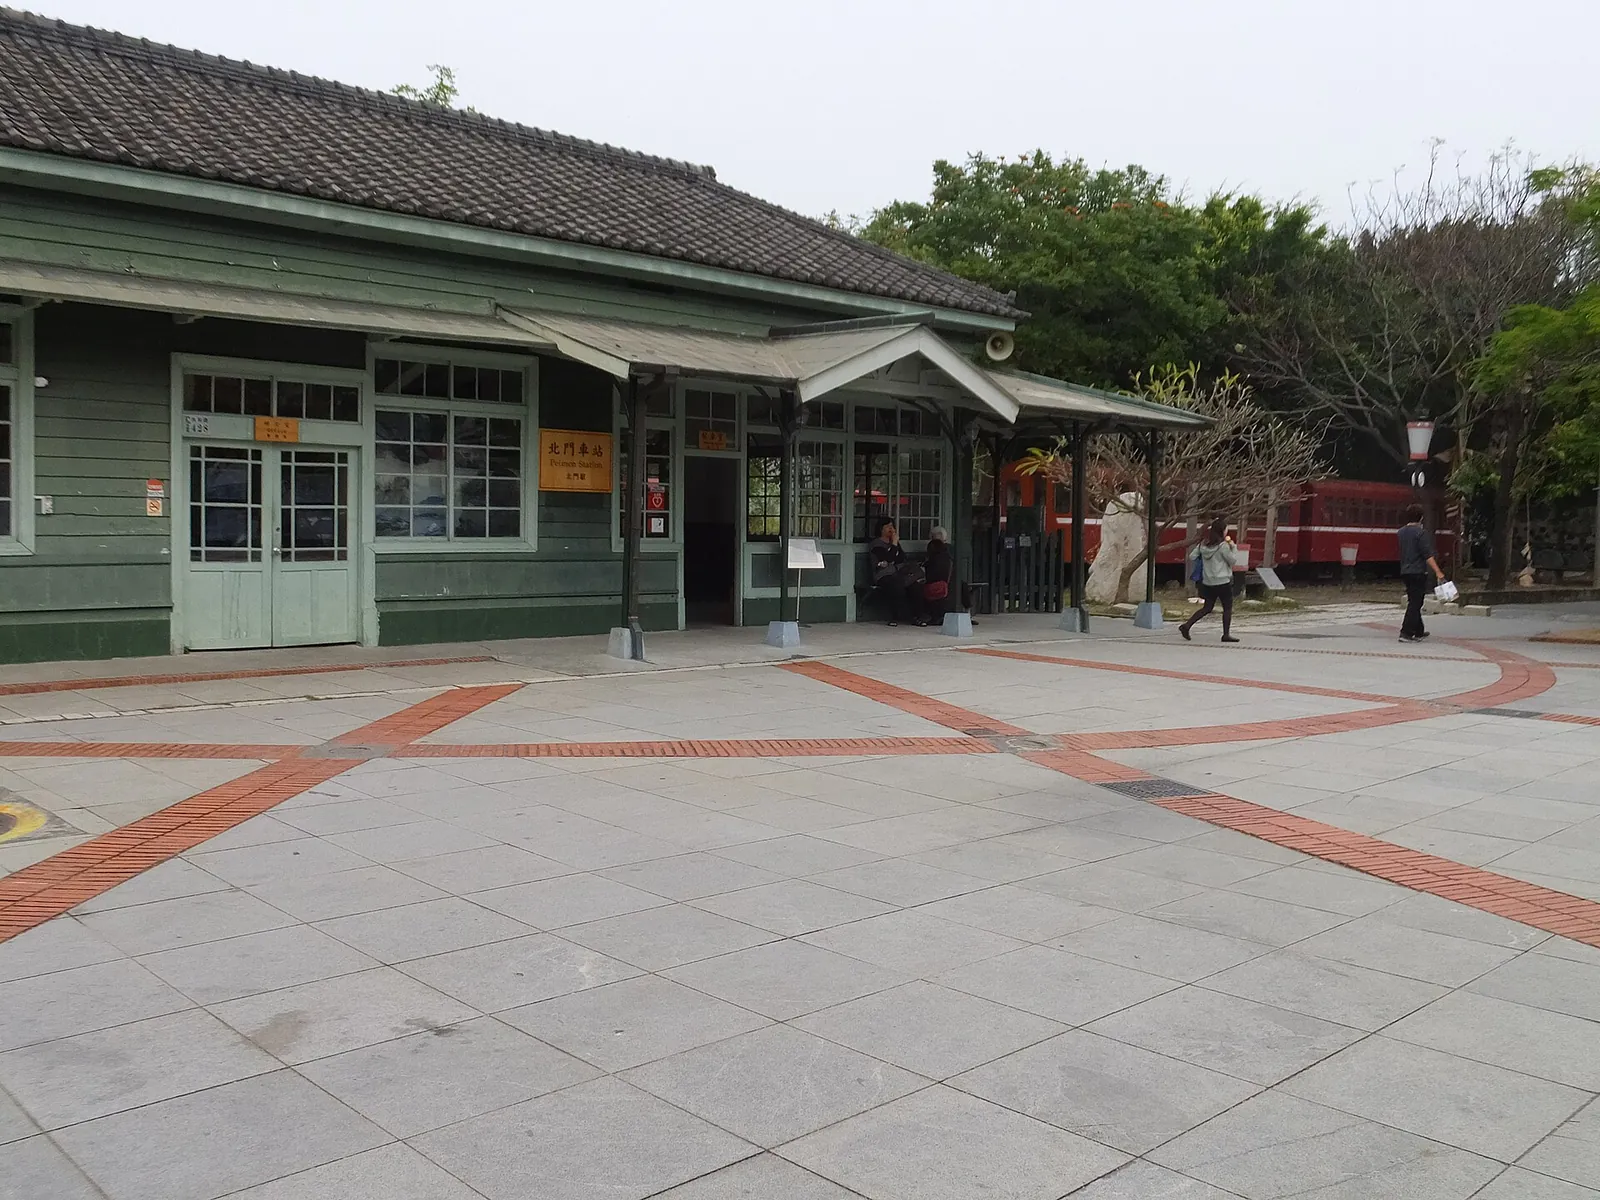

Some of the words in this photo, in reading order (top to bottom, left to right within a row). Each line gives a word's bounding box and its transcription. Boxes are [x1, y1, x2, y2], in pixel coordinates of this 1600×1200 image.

[548, 442, 603, 457] 北門車站
[578, 460, 603, 469] Station
